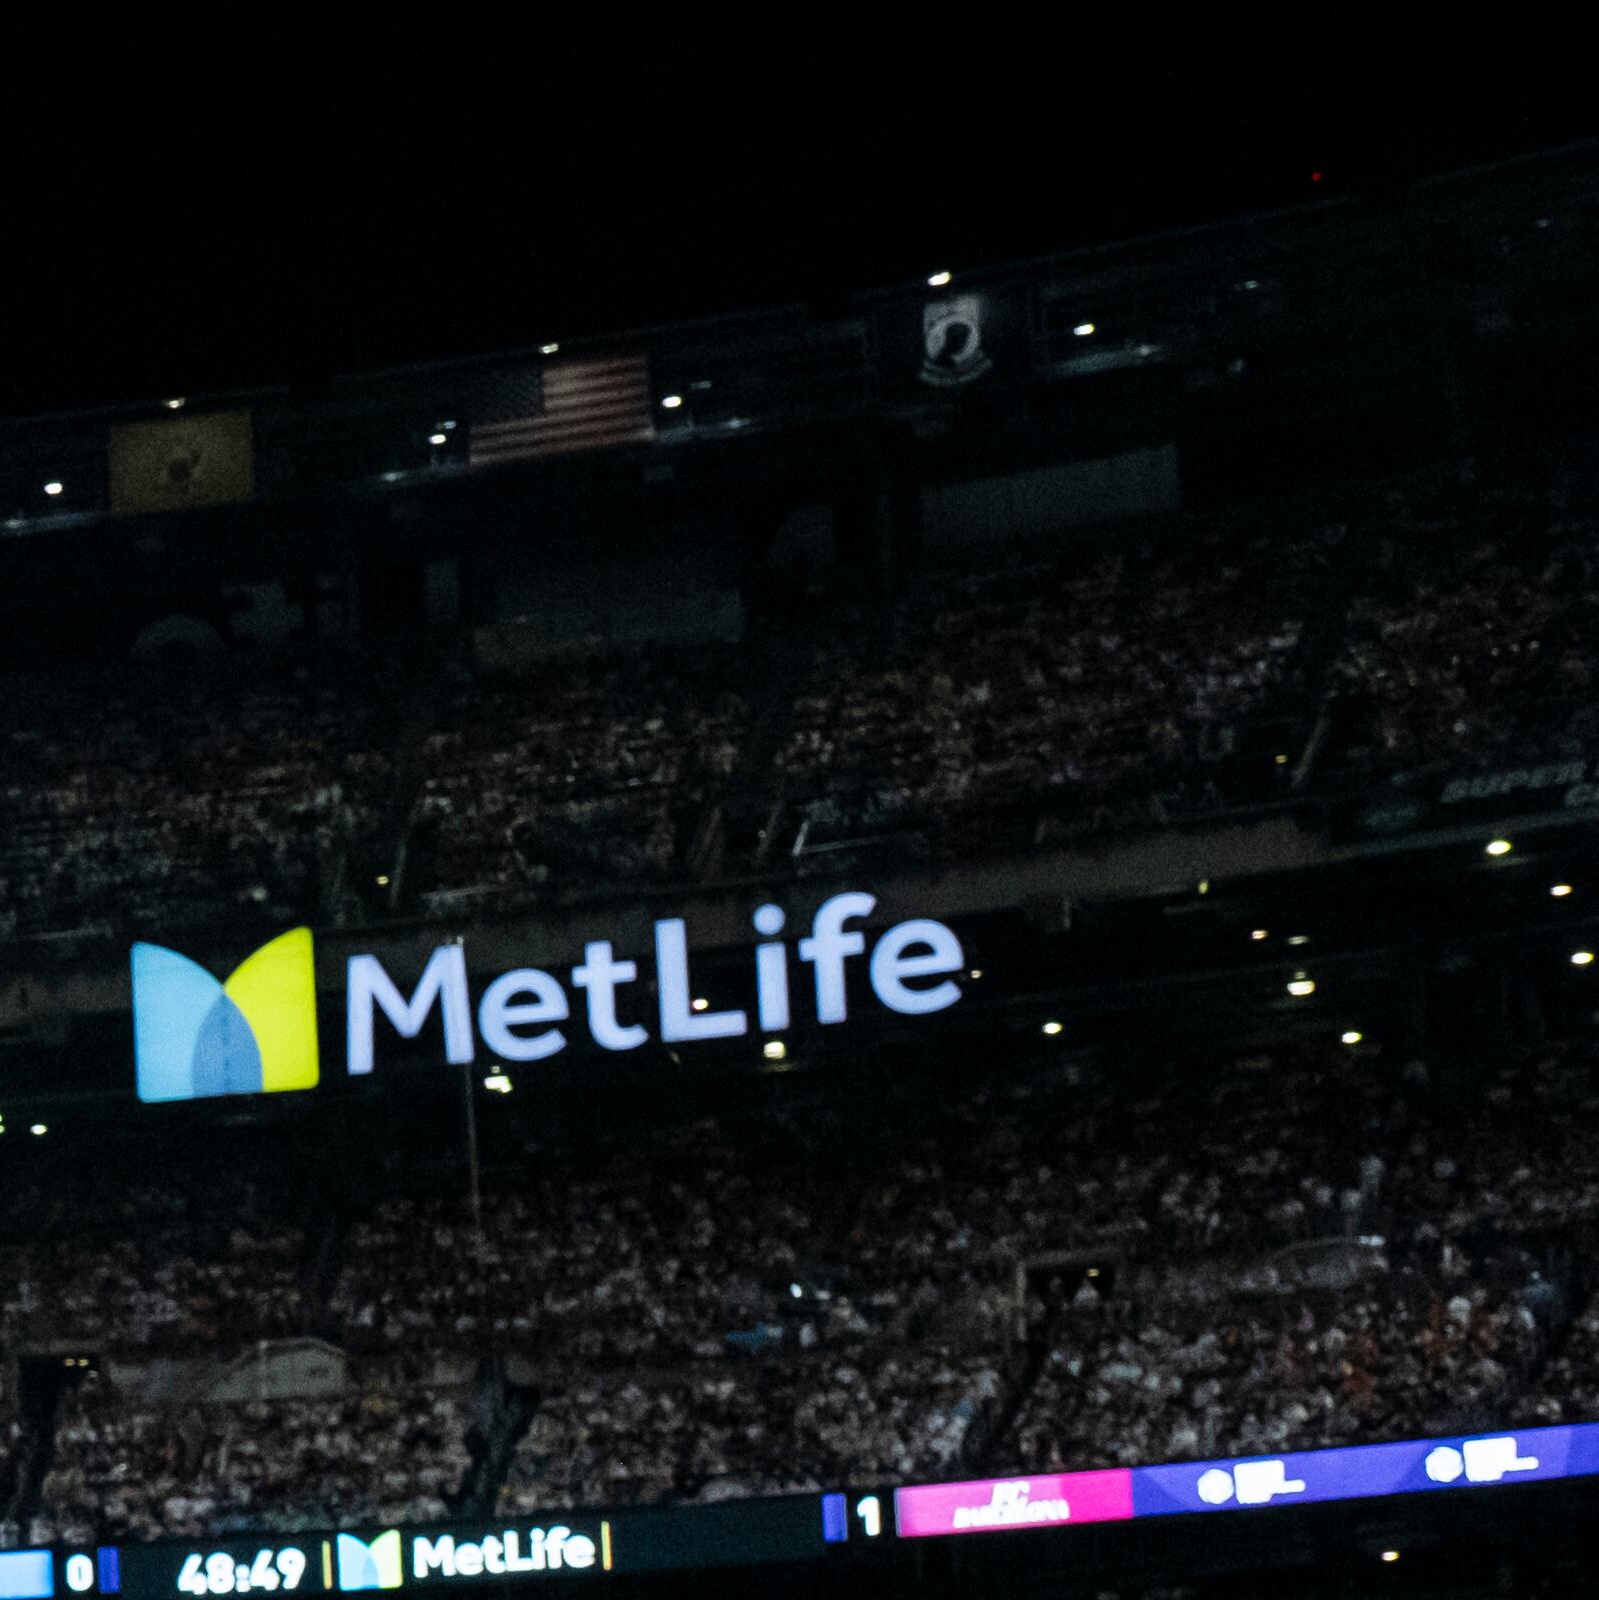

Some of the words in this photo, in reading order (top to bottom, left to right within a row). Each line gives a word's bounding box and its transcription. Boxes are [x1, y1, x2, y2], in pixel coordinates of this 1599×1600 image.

[347, 891, 964, 1076] MetLife
[857, 1496, 880, 1536] 1
[66, 1554, 94, 1591] 0
[177, 1548, 306, 1595] 48:49
[413, 1525, 596, 1577] MetLife
